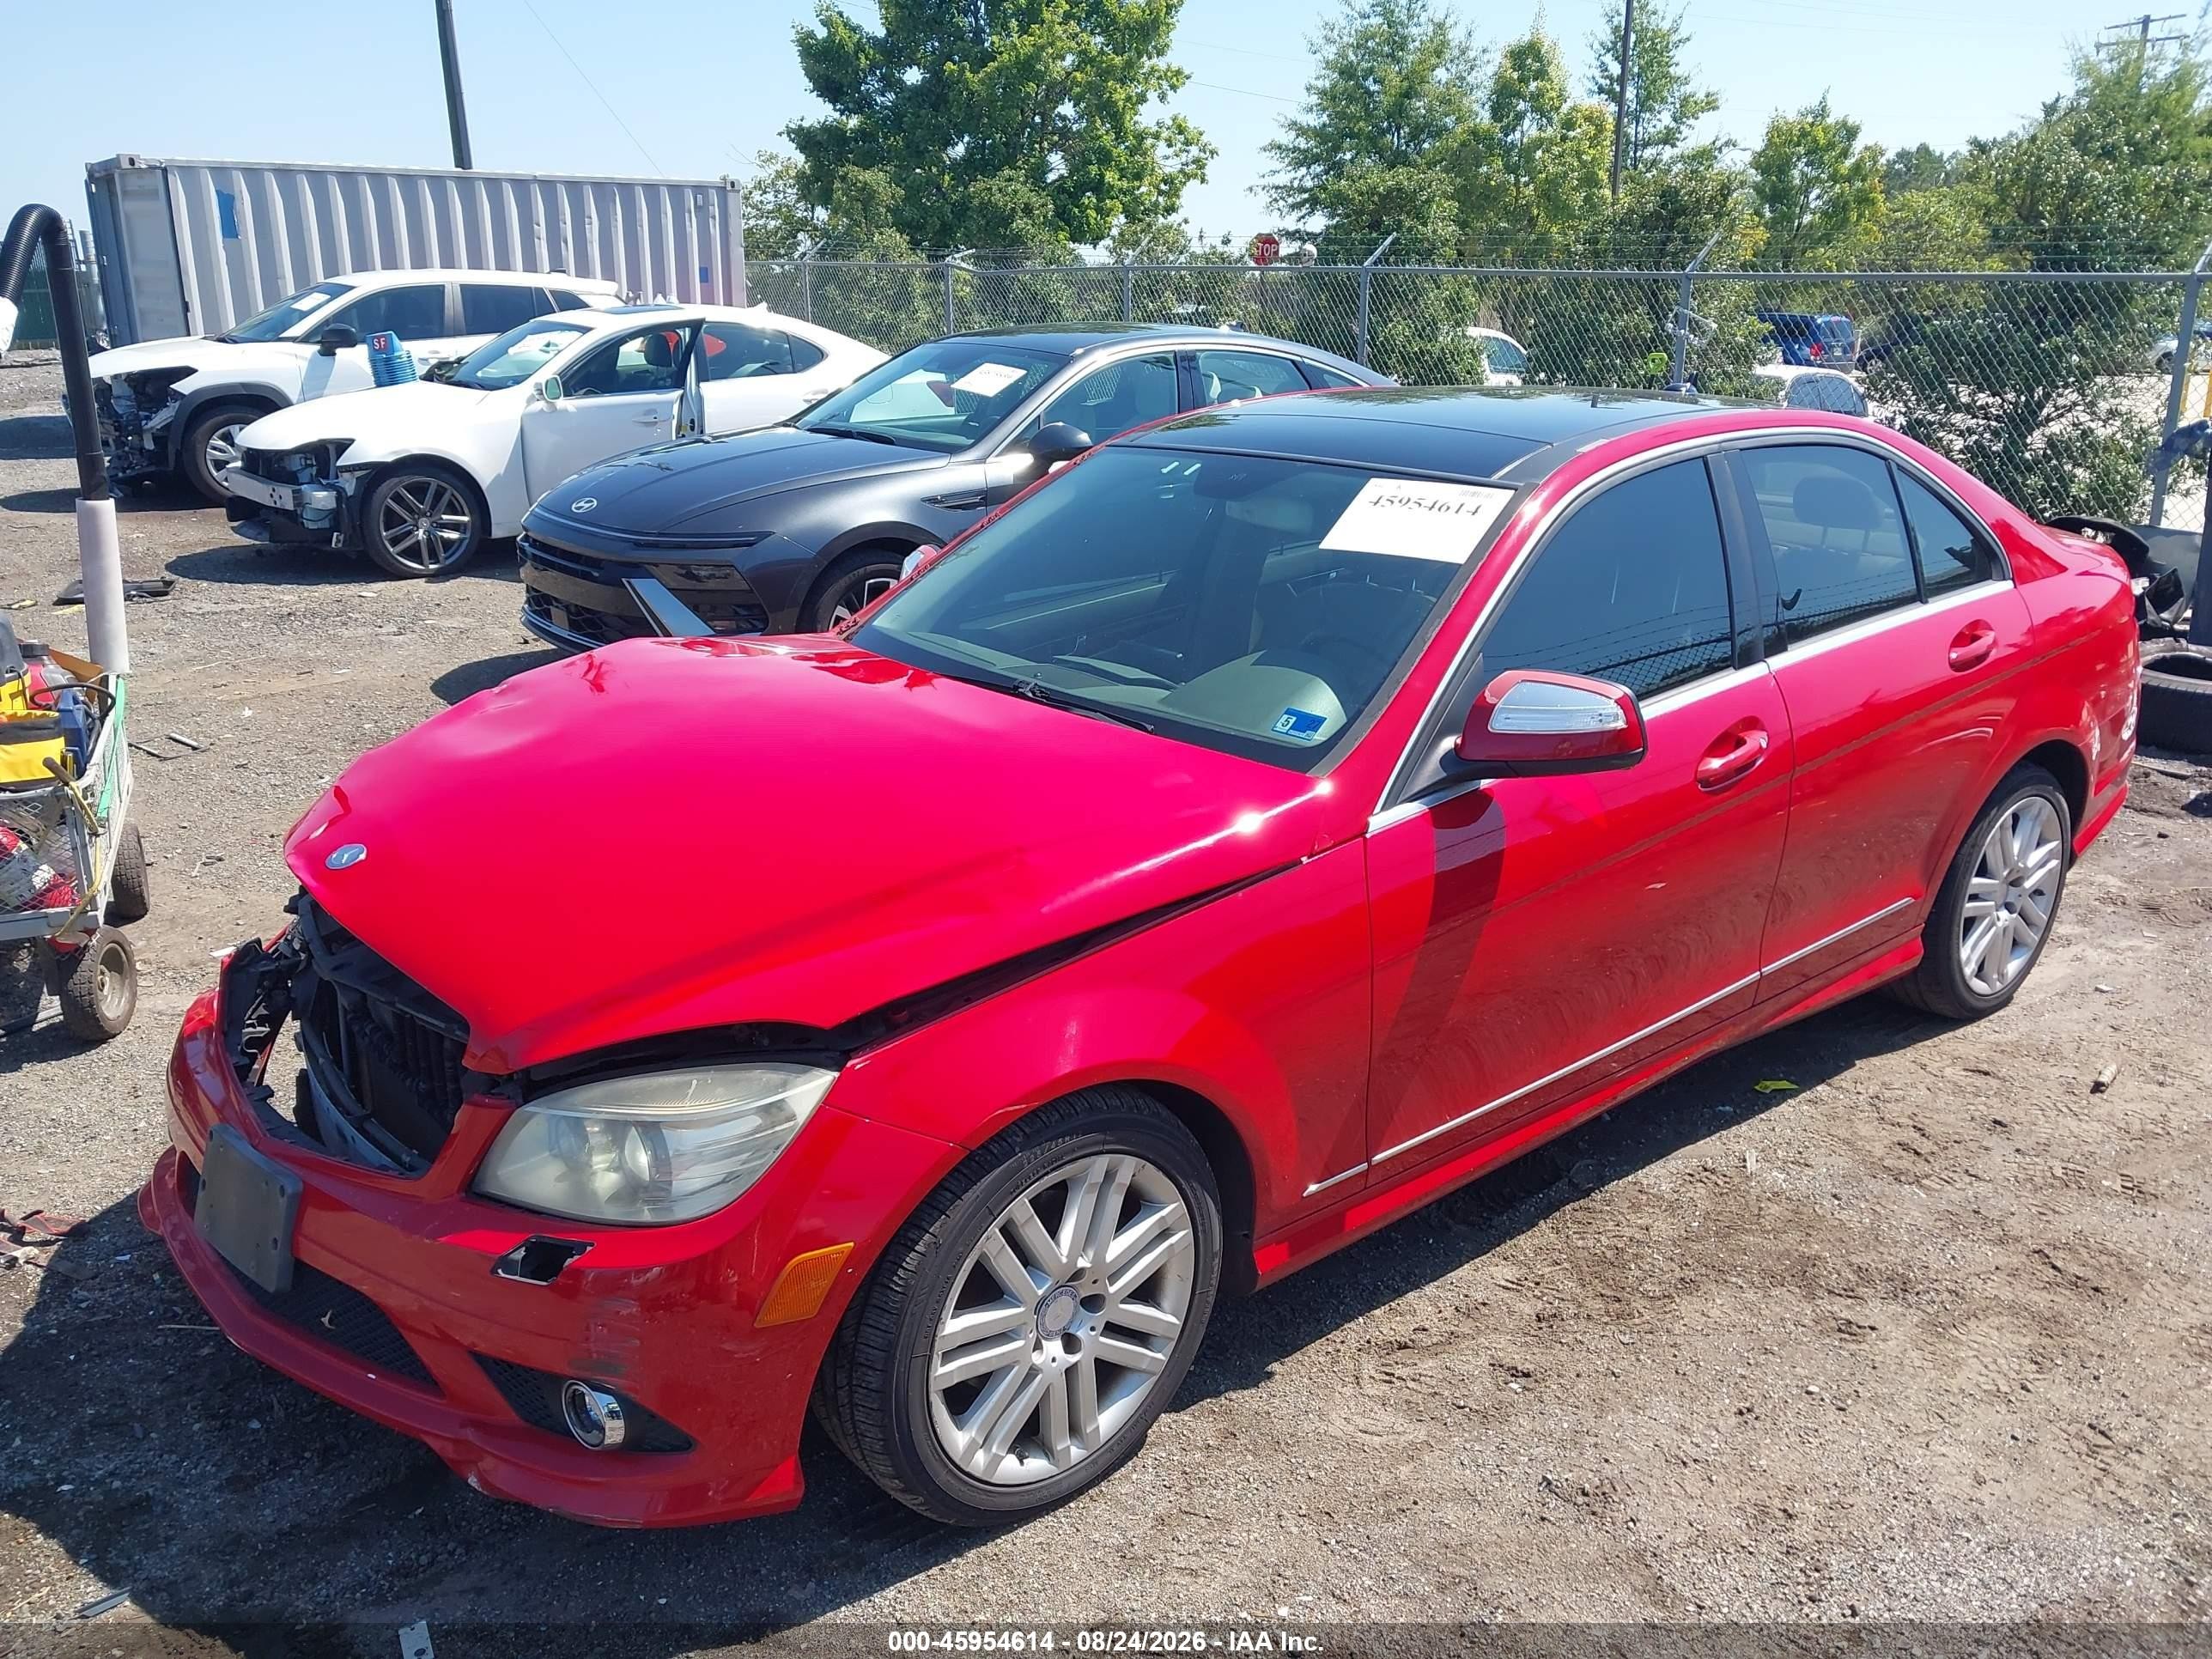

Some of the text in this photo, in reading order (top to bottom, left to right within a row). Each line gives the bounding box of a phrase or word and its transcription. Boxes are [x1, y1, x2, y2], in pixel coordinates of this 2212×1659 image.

[1252, 242, 1278, 257] TOP
[373, 337, 386, 349] SF
[1368, 495, 1483, 516] 45954614
[1281, 717, 1293, 727] 5
